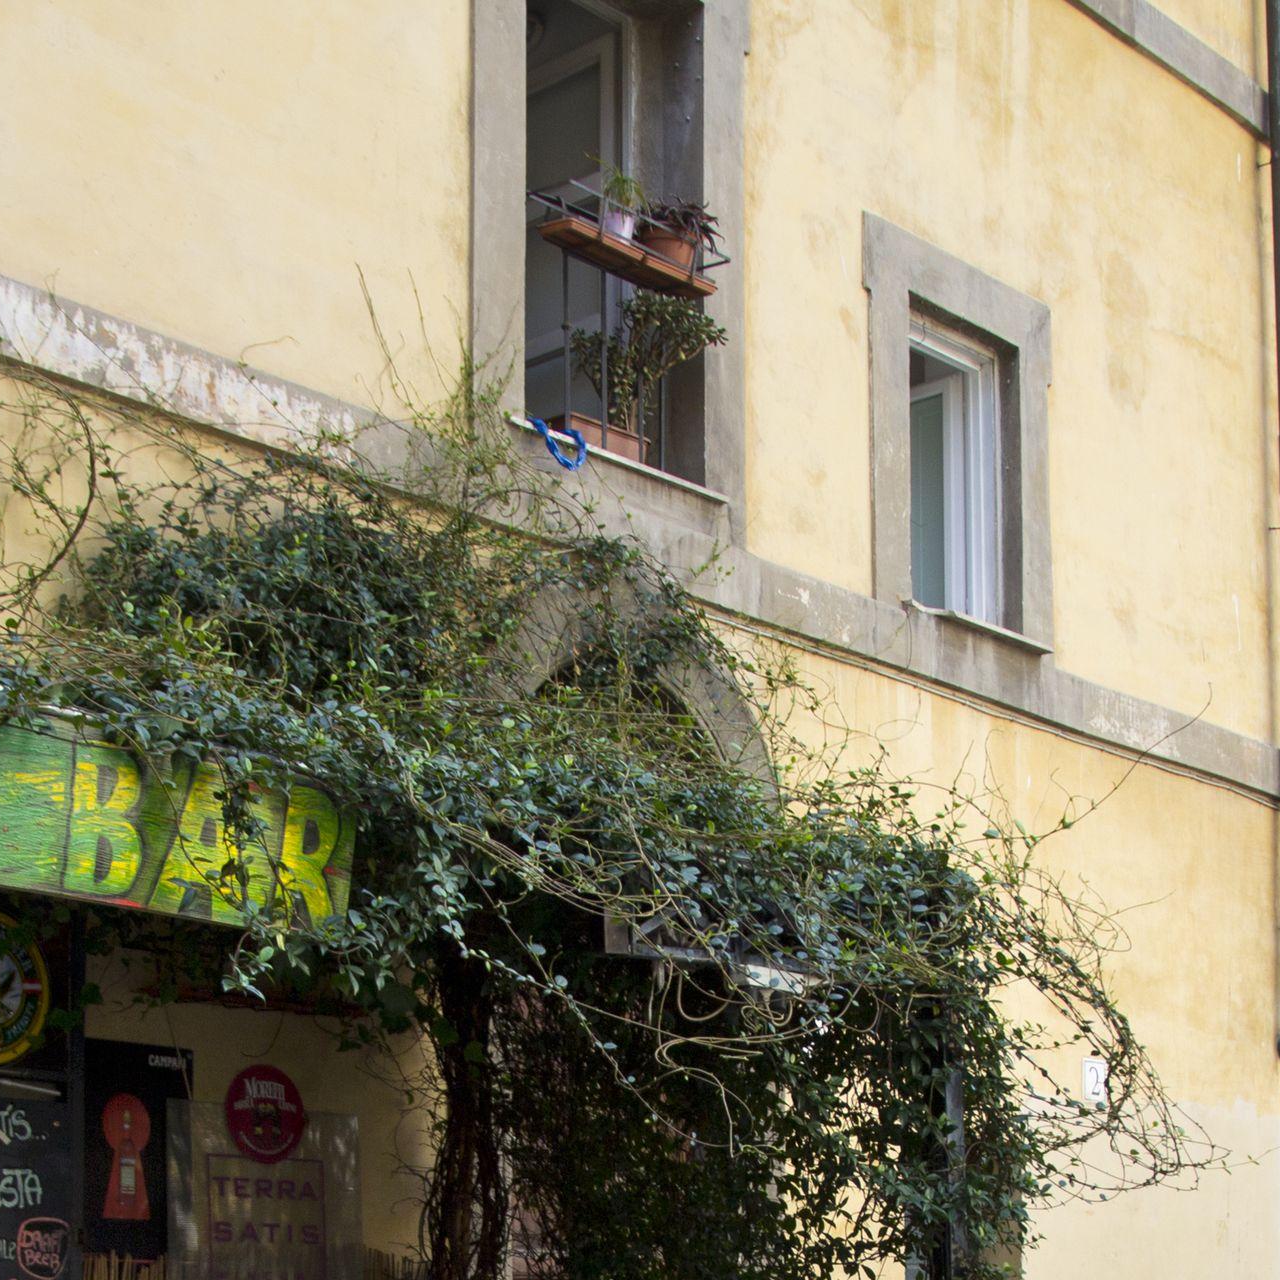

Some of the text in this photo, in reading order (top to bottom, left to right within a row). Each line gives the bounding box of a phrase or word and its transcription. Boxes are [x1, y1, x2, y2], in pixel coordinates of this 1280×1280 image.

[60, 740, 344, 930] BAR
[211, 1176, 319, 1200] TERRA
[212, 1222, 320, 1244] SATIS
